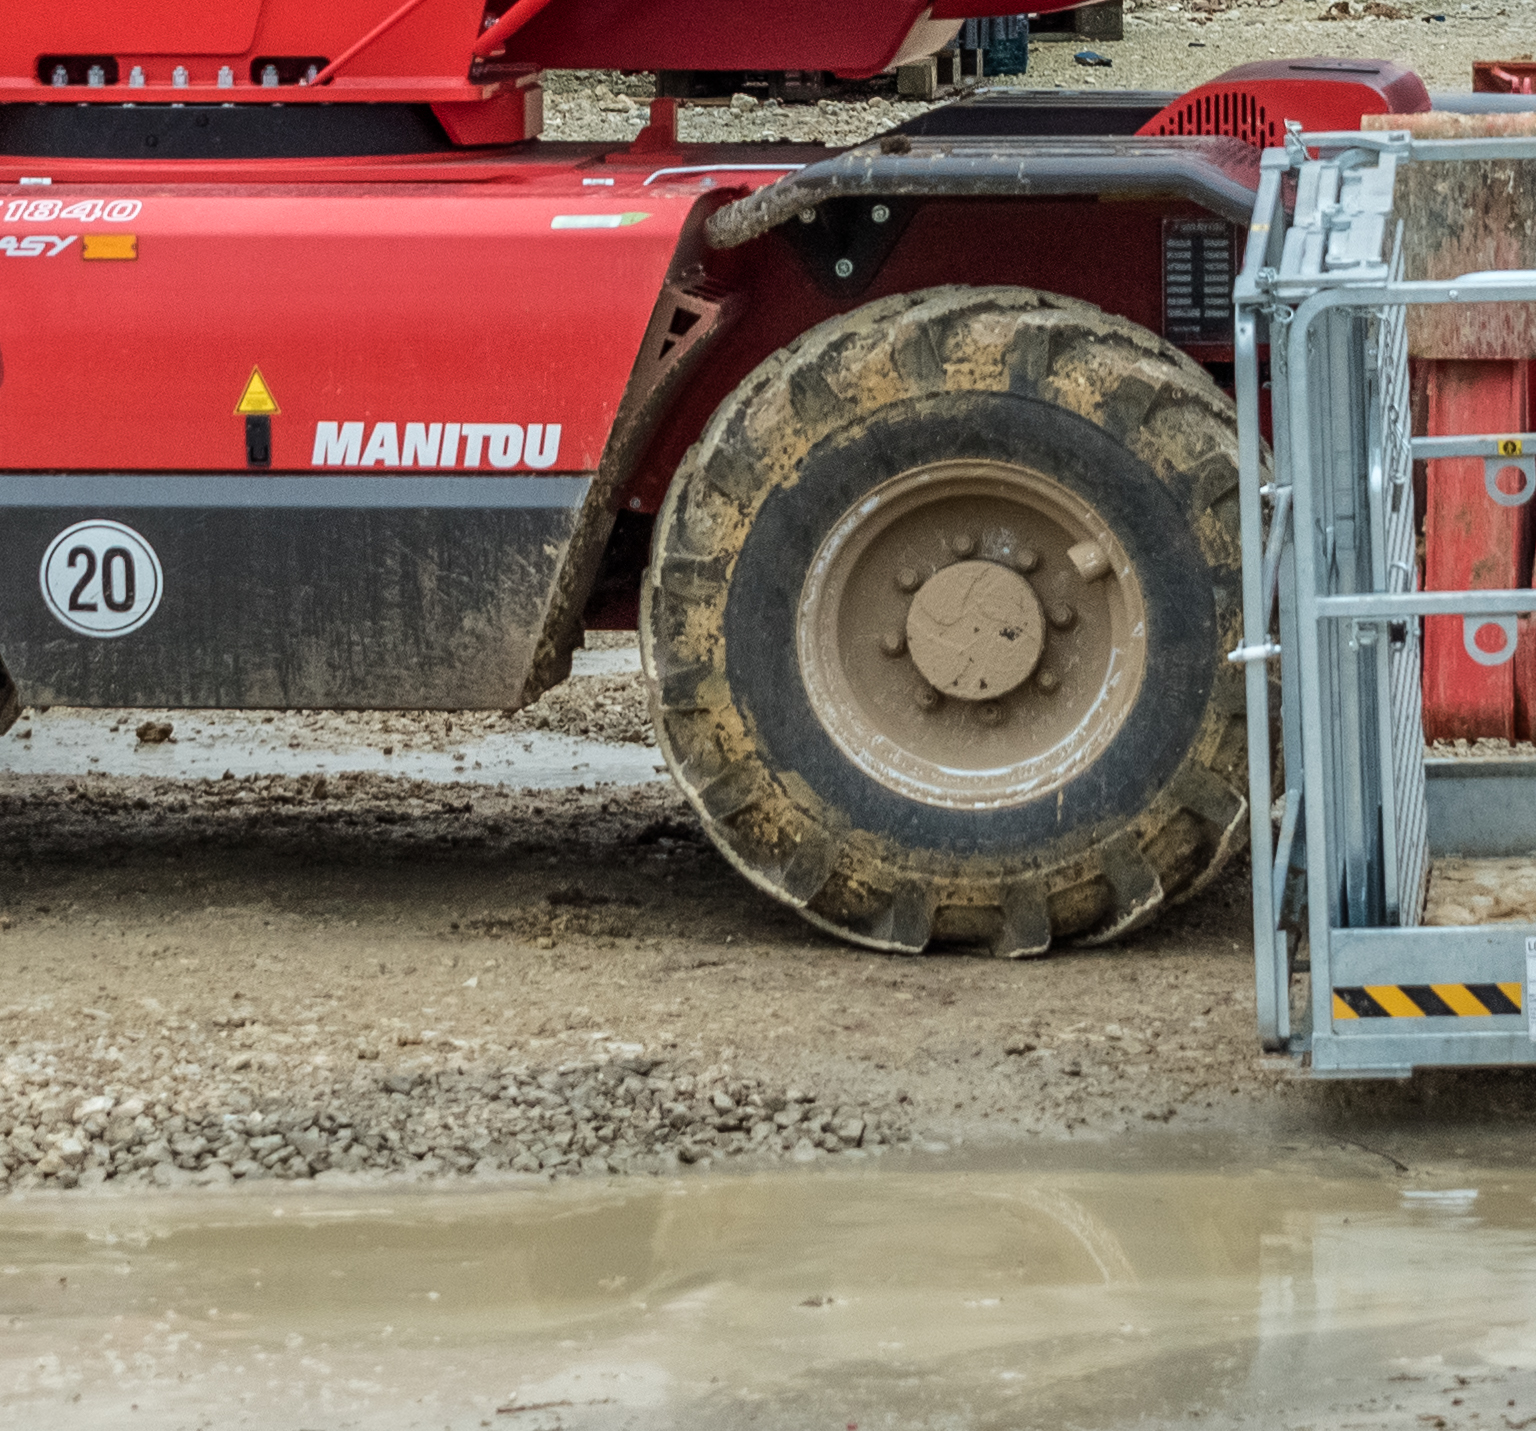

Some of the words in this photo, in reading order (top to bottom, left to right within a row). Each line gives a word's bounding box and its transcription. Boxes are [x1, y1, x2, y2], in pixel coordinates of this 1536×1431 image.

[4, 199, 143, 222] 1840
[312, 420, 562, 469] MANITOU
[66, 545, 137, 613] 20
